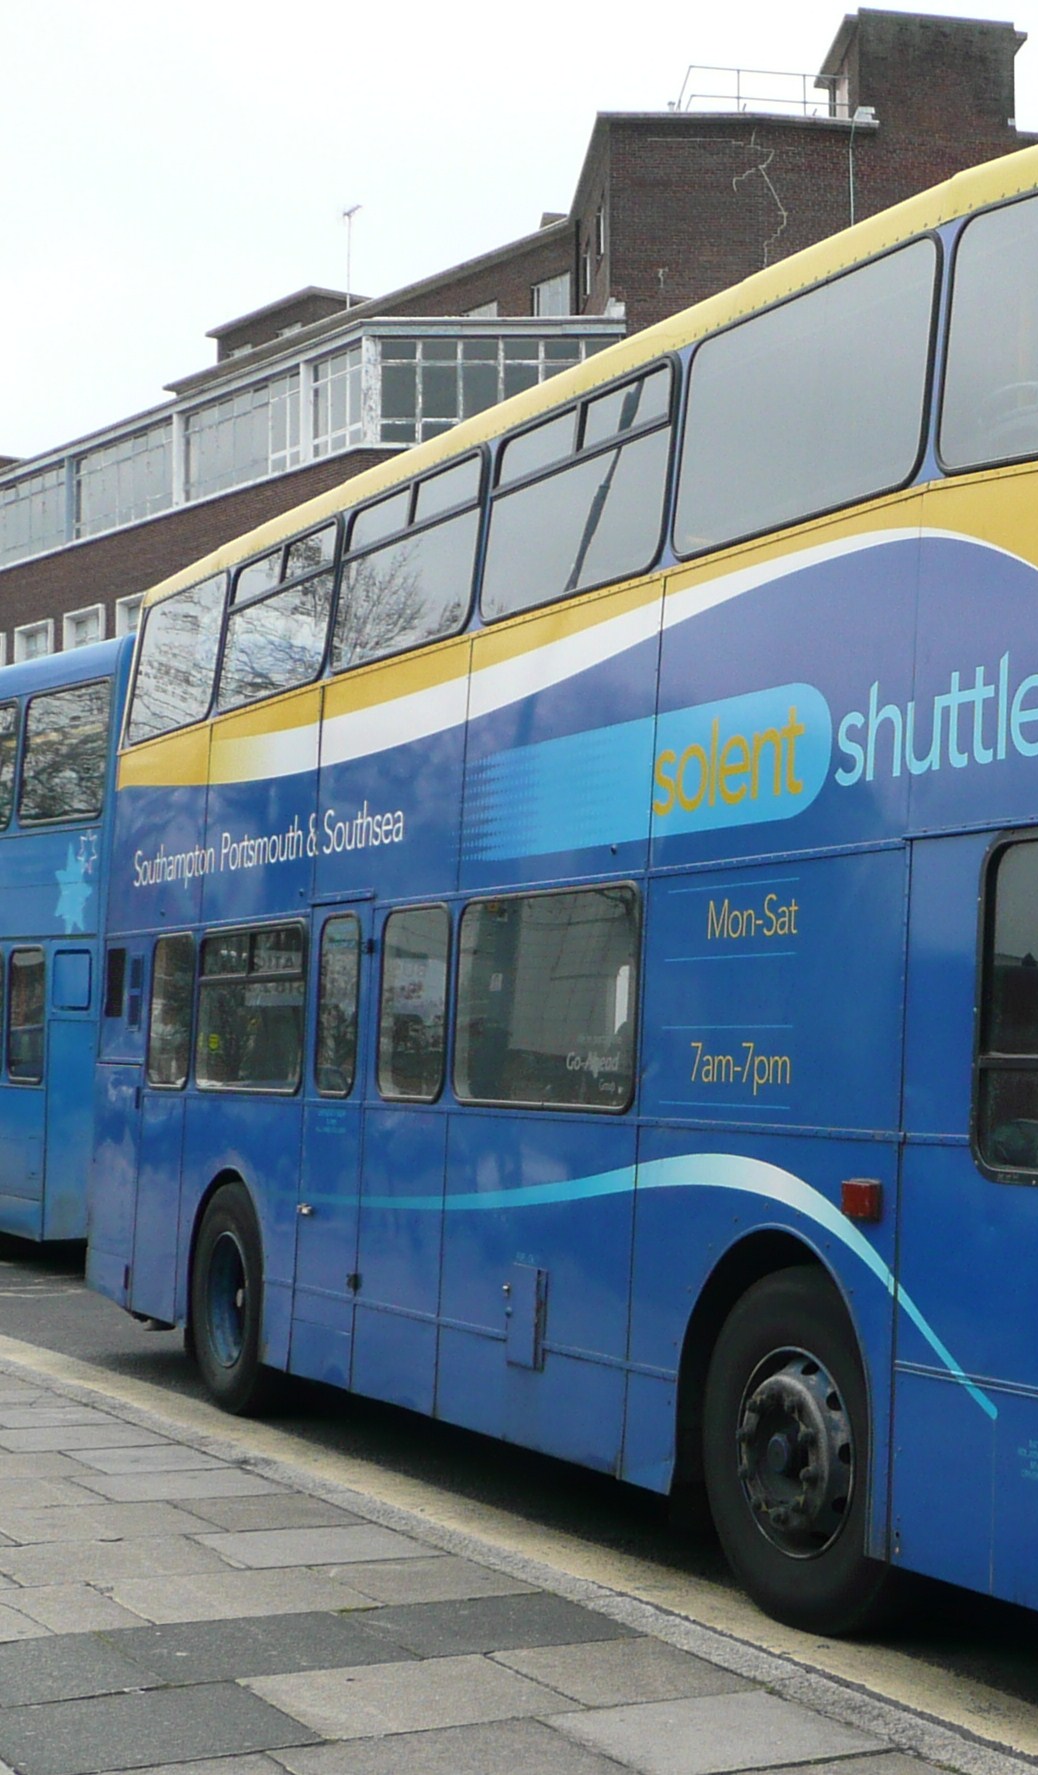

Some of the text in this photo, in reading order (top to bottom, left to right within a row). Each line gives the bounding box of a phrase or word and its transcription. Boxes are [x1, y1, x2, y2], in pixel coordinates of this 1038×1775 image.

[653, 706, 805, 816] solent
[133, 800, 404, 889] Southampton Portsmouth & Southsea
[707, 893, 799, 940] Mon-Sat
[690, 1042, 791, 1096] 7am-7pm
